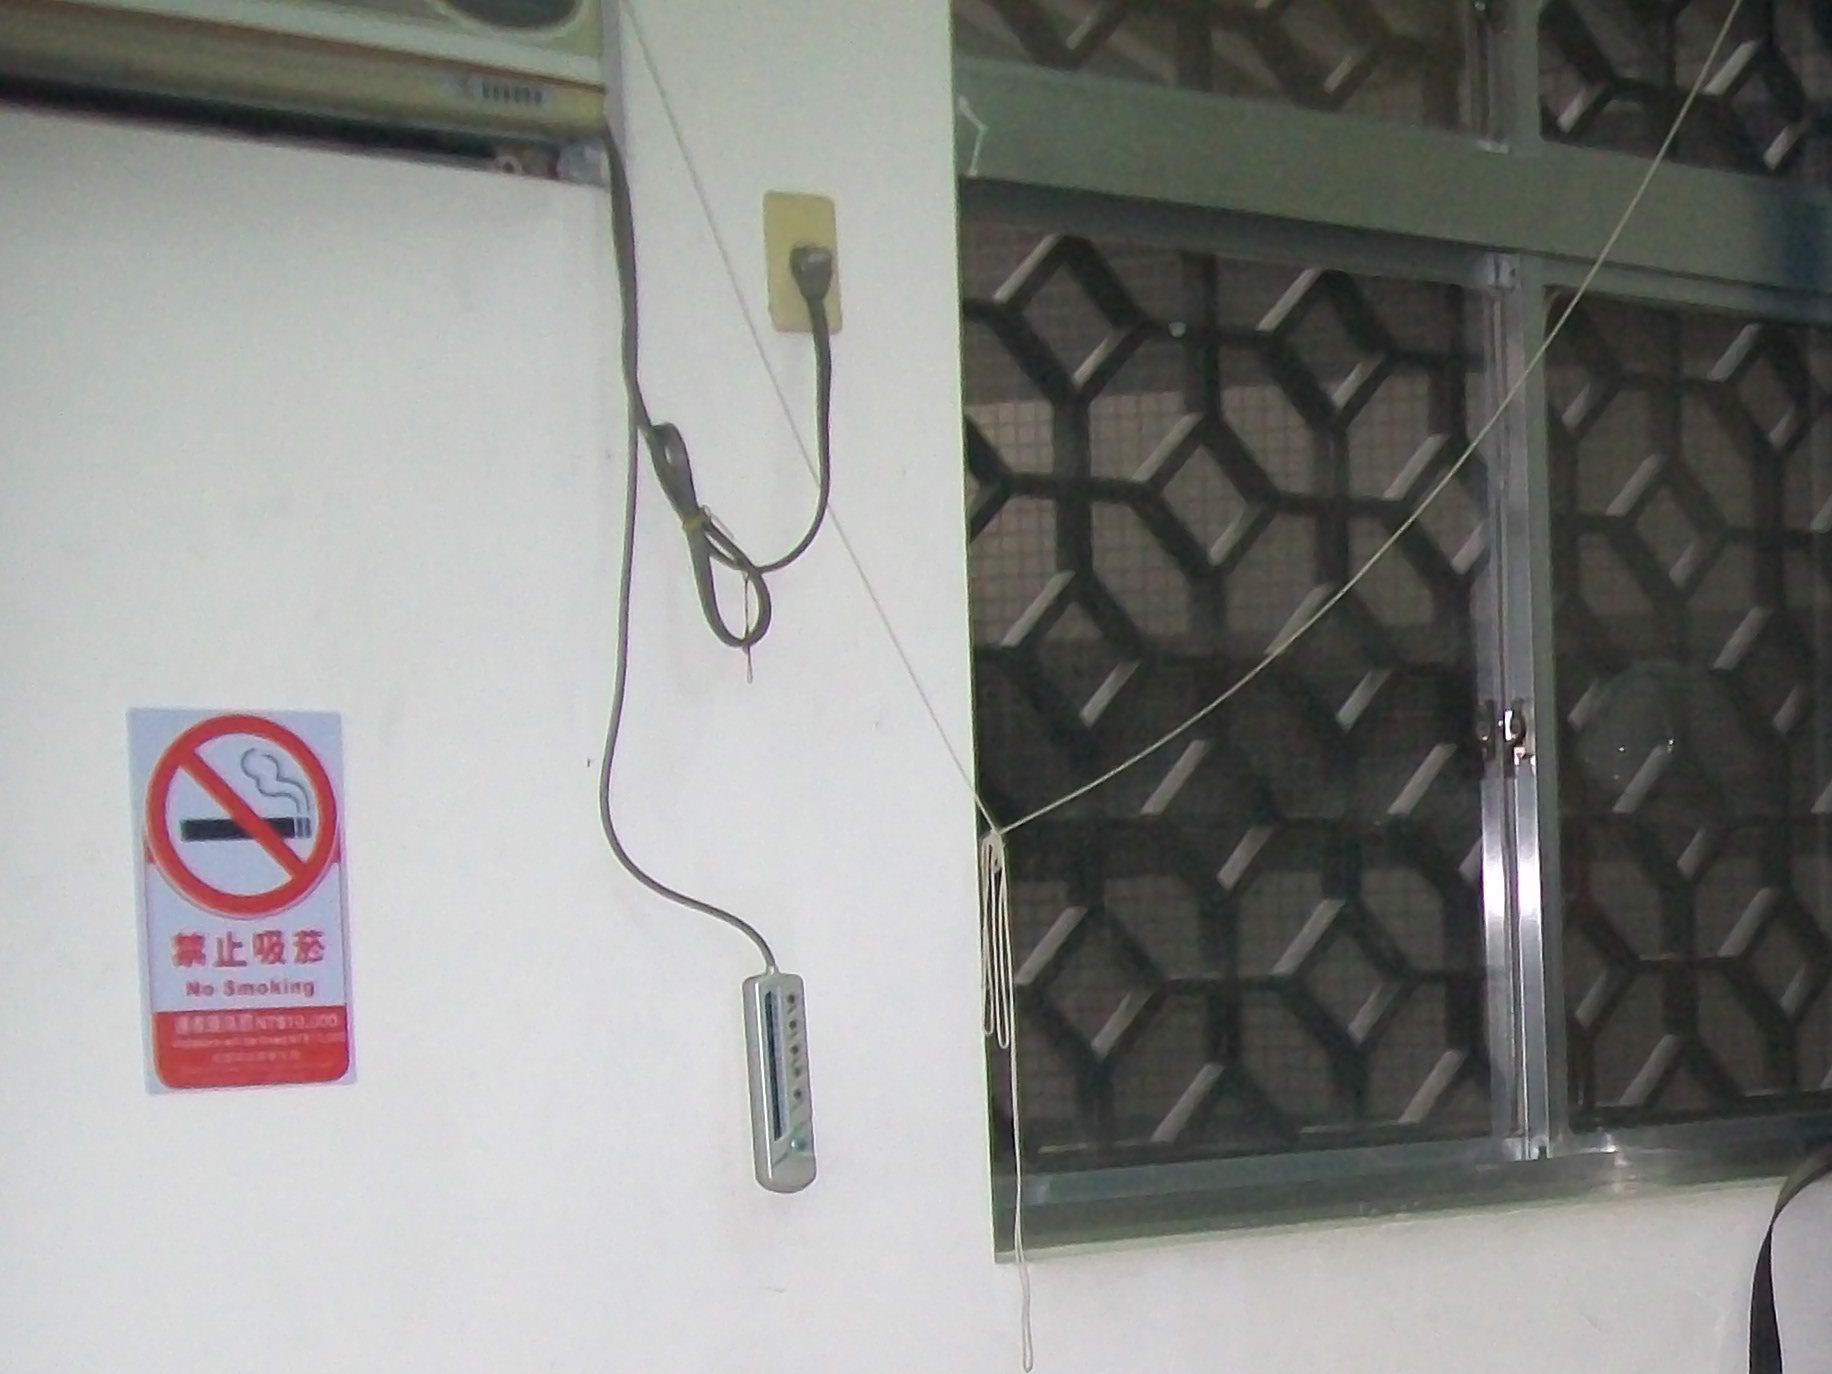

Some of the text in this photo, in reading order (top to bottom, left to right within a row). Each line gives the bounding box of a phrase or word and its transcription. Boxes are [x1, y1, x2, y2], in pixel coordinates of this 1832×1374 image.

[172, 930, 325, 968] 禁止吸菸
[186, 978, 314, 997] No Smoking
